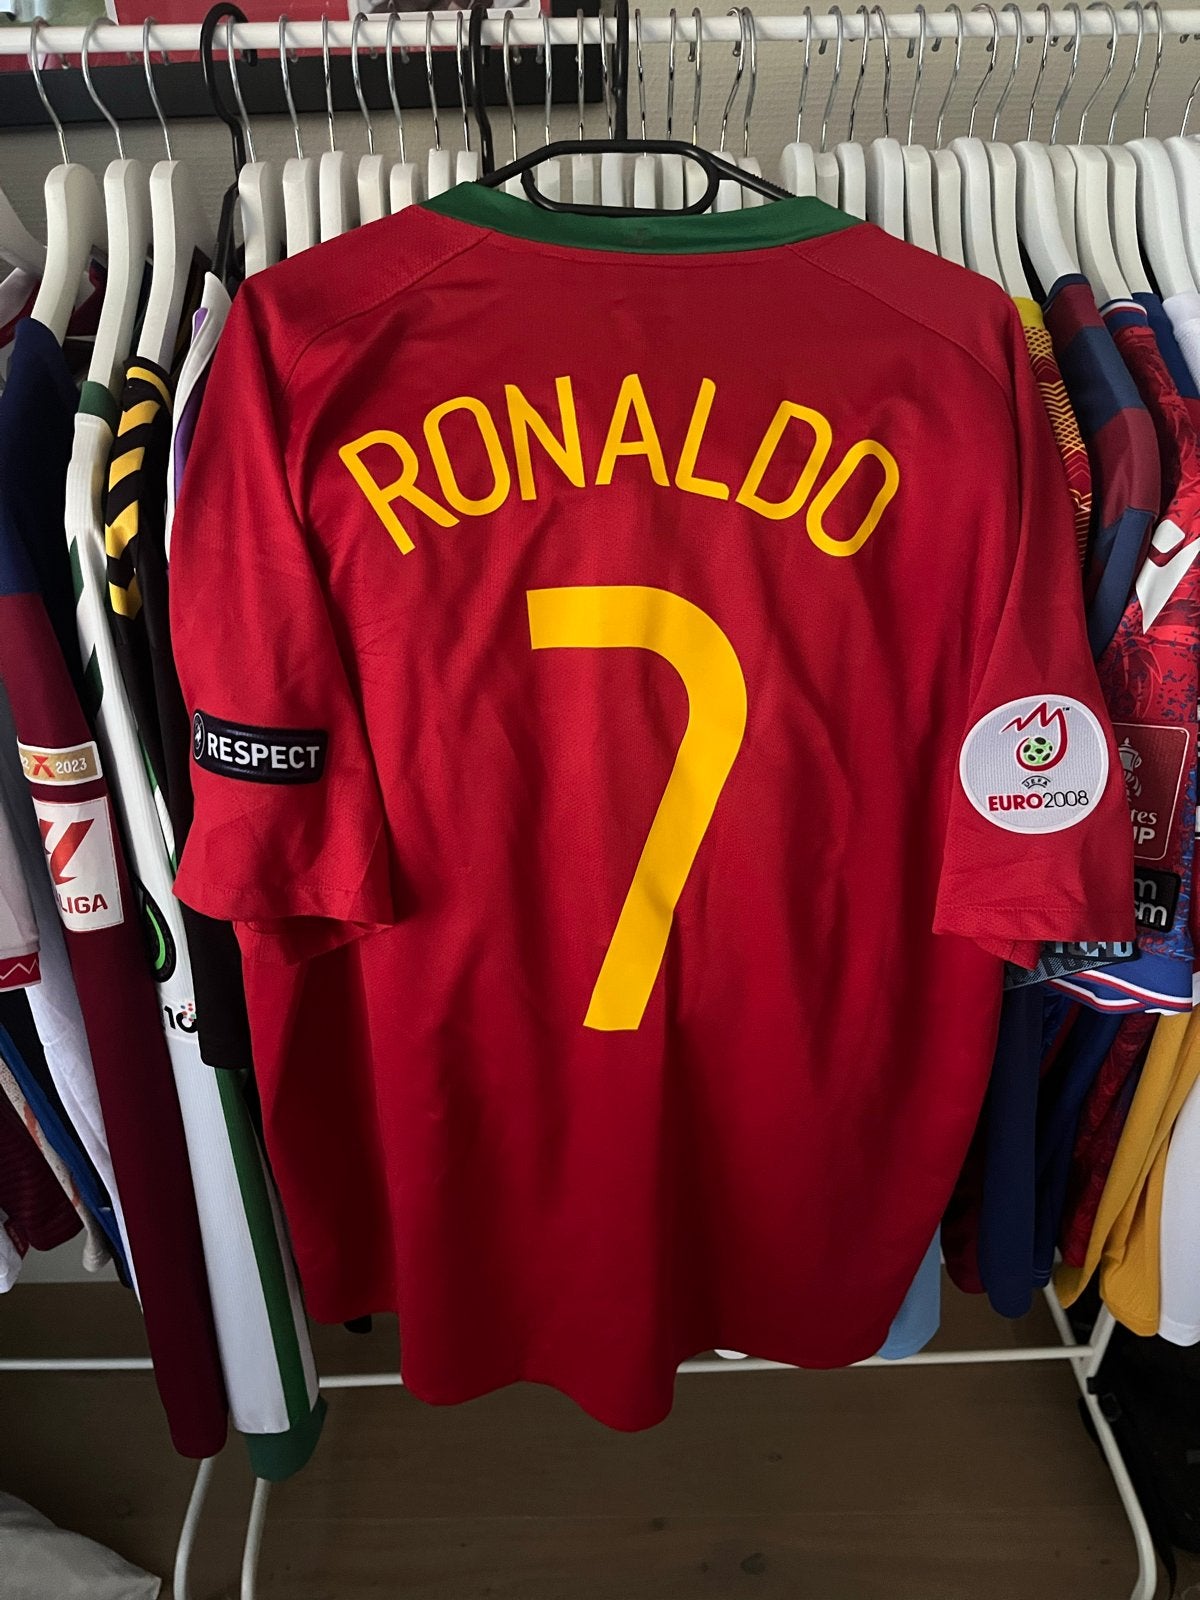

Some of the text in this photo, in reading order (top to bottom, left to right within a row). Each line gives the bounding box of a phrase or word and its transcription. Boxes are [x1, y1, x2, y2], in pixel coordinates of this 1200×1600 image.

[338, 373, 900, 556] RONALDO
[207, 732, 320, 769] RESPECT
[55, 757, 88, 775] 2023
[1024, 778, 1048, 788] UEFA
[526, 585, 747, 1031] 7
[56, 893, 109, 914] LIGA
